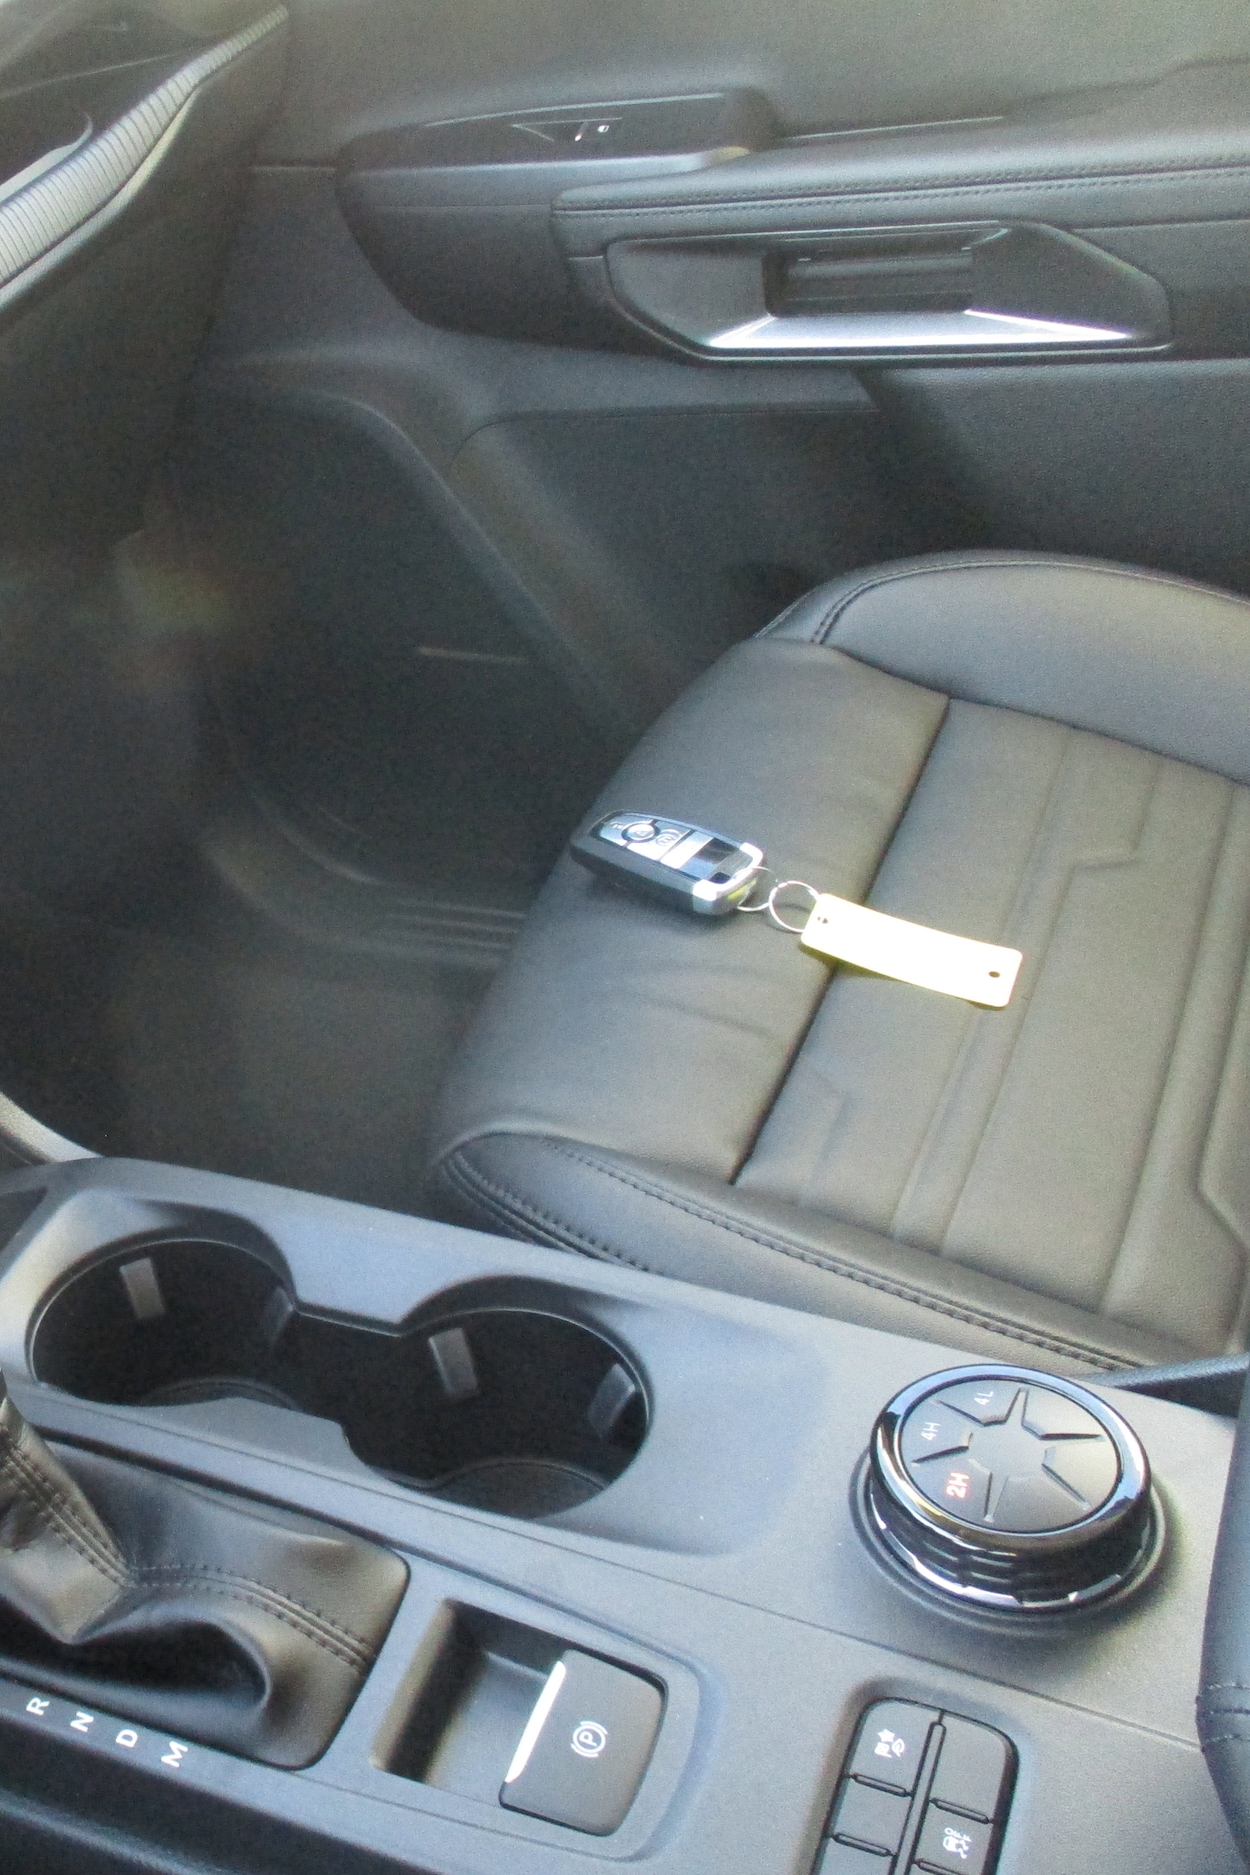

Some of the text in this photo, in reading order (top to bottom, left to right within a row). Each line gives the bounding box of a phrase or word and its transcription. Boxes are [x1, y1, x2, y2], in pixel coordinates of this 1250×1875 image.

[973, 1390, 994, 1407] 4L
[920, 1421, 942, 1441] 4H
[945, 1472, 970, 1499] 2H
[26, 1696, 49, 1716] R
[70, 1711, 94, 1732] N
[115, 1729, 139, 1748] D
[161, 1740, 189, 1768] M
